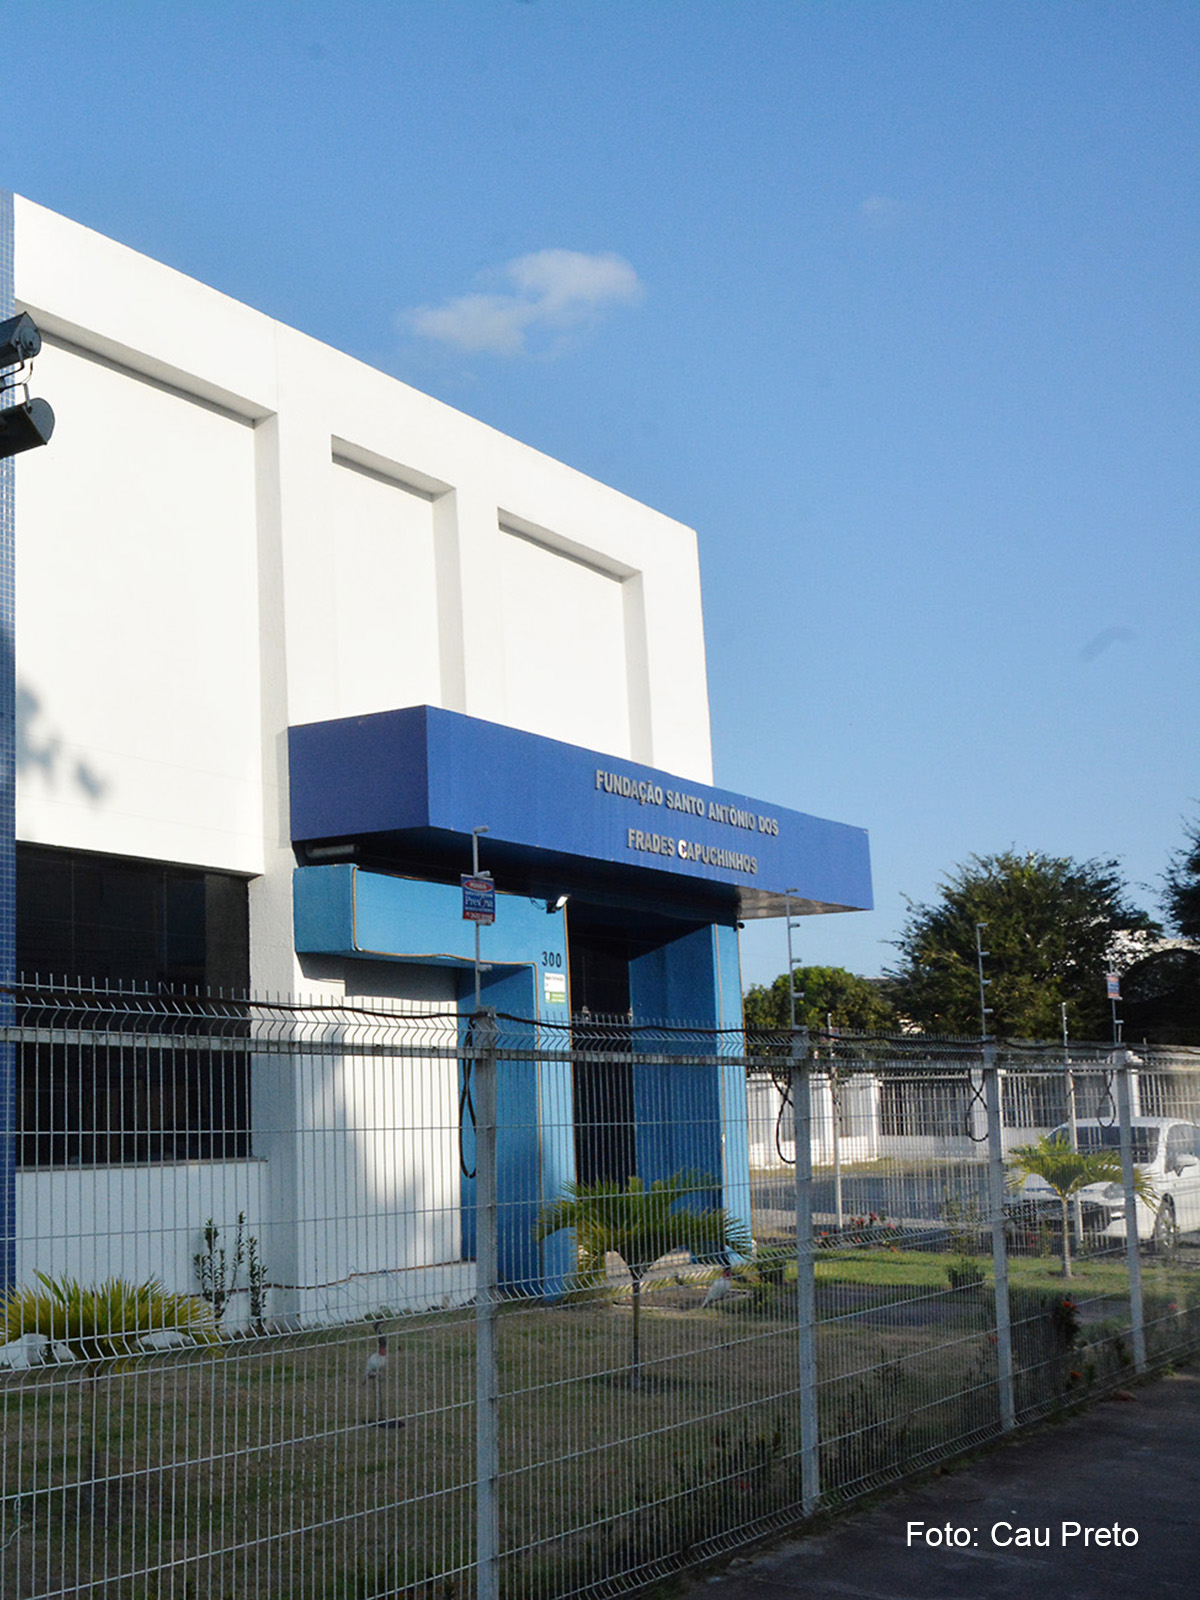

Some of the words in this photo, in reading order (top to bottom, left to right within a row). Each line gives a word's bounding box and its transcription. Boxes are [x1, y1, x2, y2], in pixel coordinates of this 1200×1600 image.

[595, 769, 663, 806] FUNDAÇÃO
[666, 790, 705, 817] SANTO
[708, 803, 756, 831] ANTÔNIO
[758, 815, 779, 836] DOS
[627, 828, 675, 857] FRADES
[677, 839, 758, 875] CAPUCHINHOS
[541, 950, 562, 968] 300
